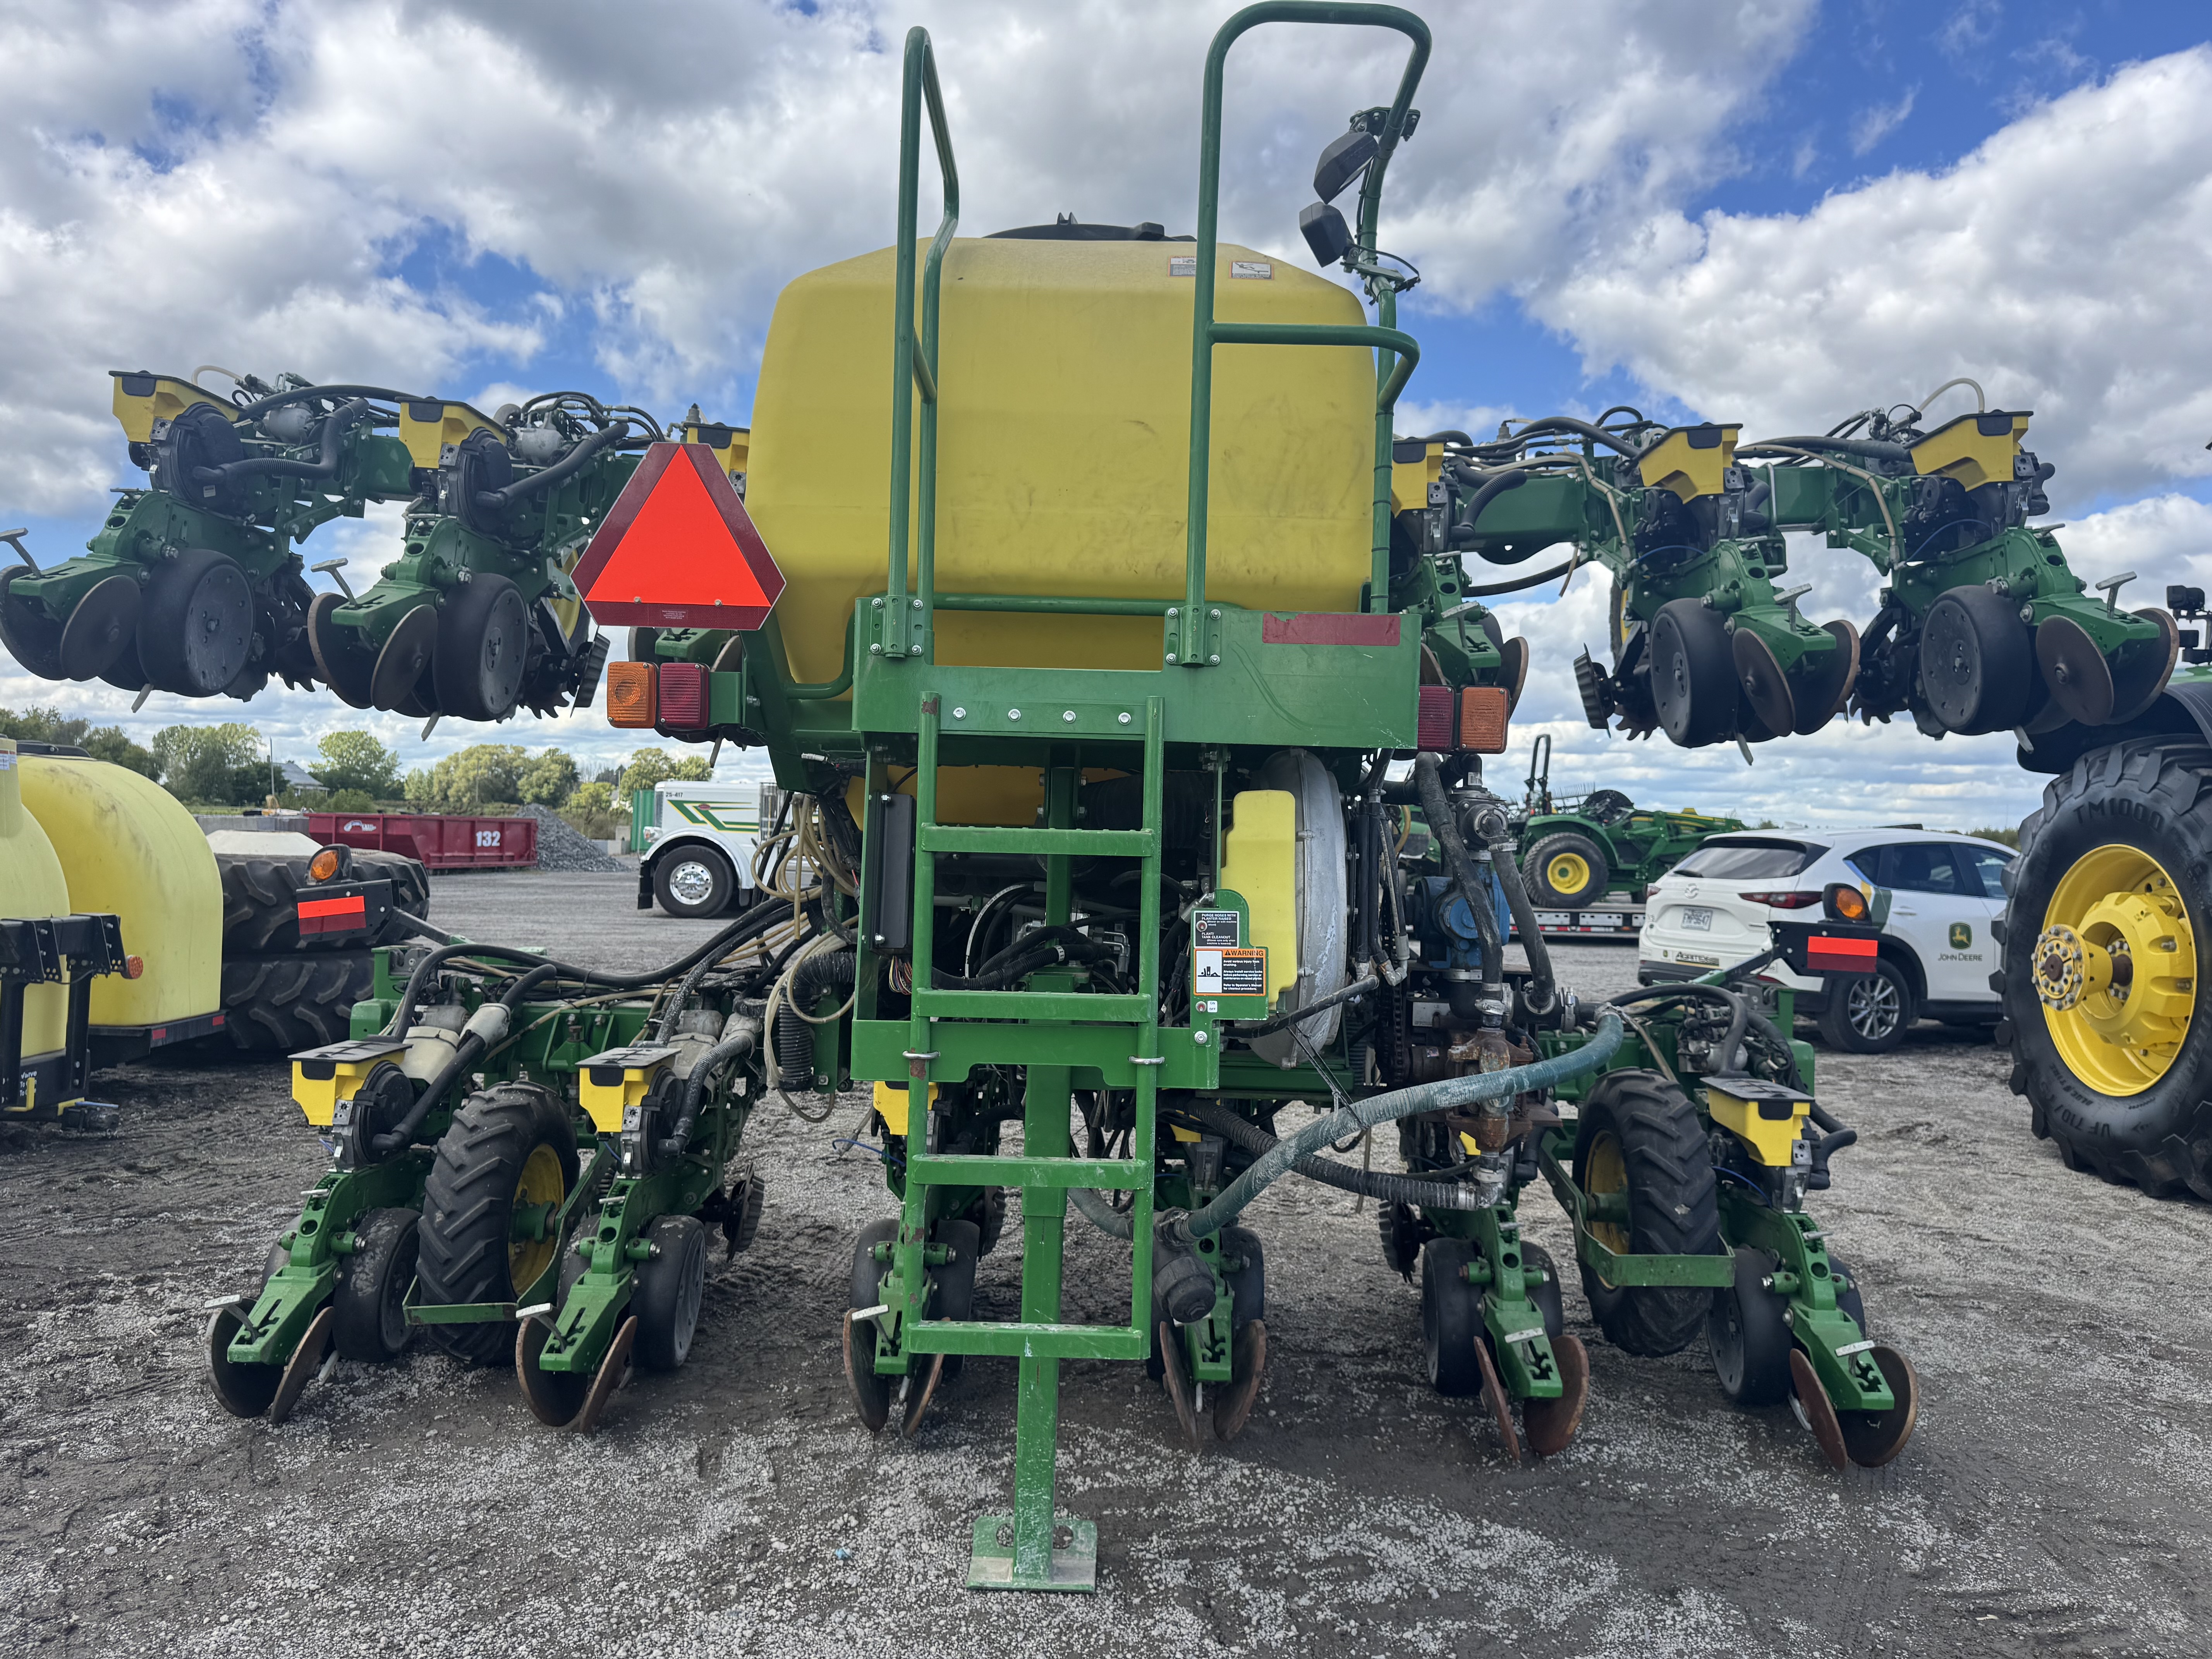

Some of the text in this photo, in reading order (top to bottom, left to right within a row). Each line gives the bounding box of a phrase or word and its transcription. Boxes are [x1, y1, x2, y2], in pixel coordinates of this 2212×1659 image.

[476, 830, 501, 847] 132
[1938, 952, 1982, 961] JOHN DEERE
[21, 1071, 37, 1079] Valve
